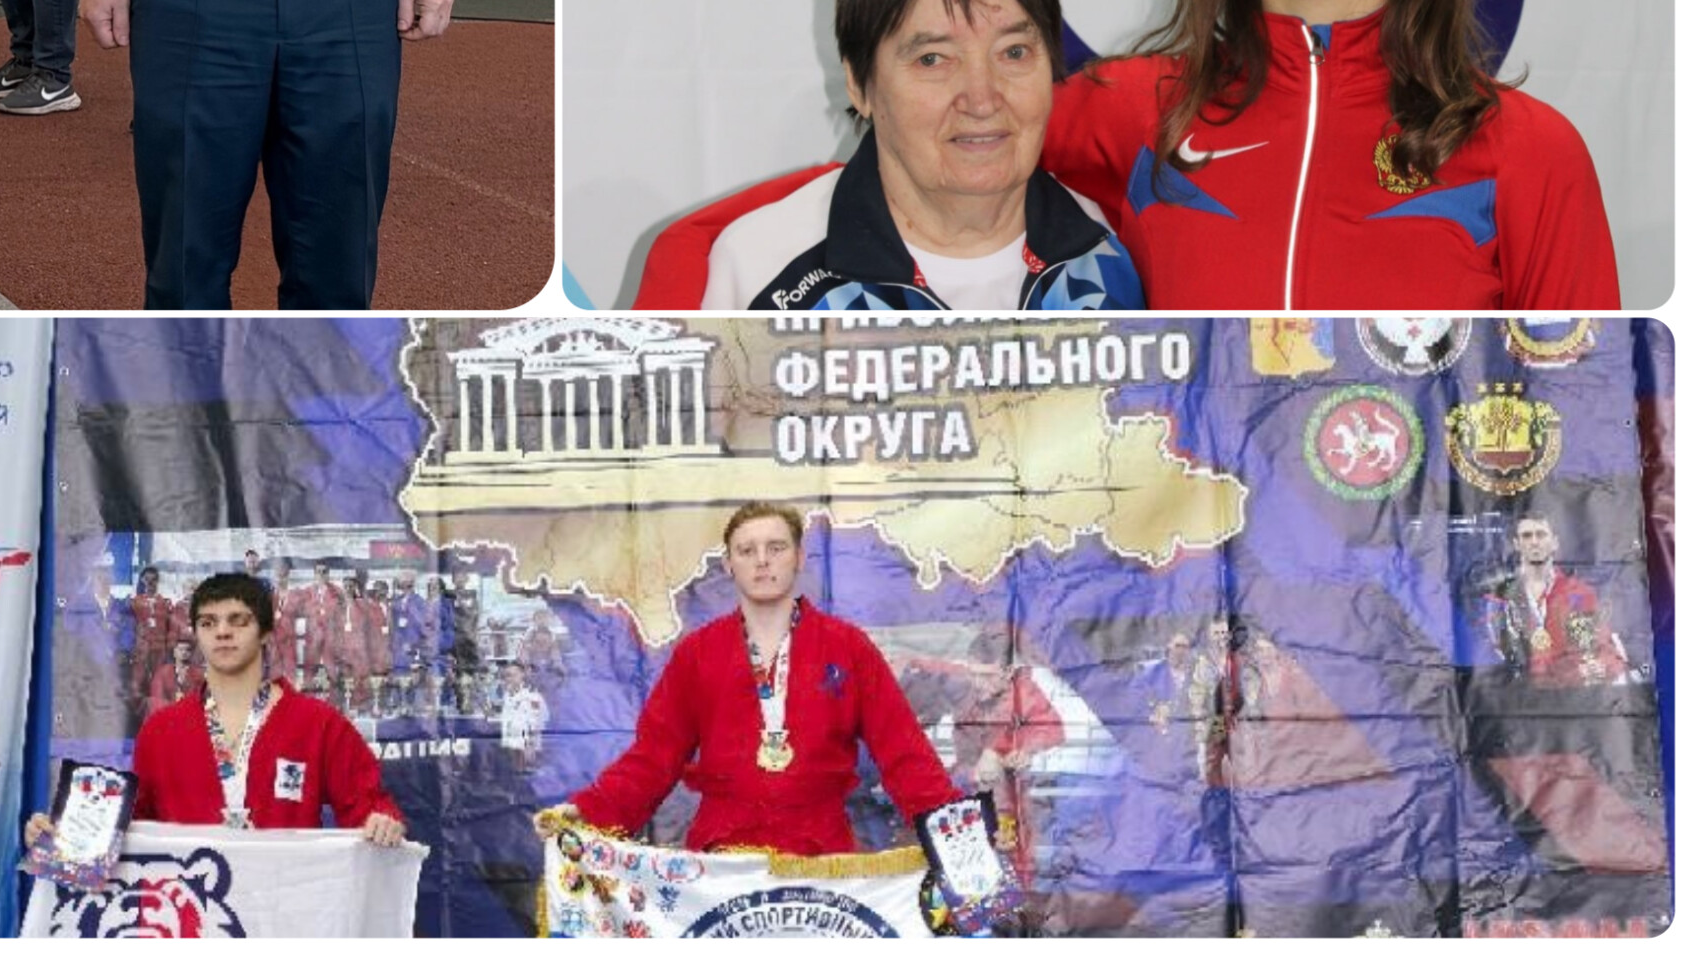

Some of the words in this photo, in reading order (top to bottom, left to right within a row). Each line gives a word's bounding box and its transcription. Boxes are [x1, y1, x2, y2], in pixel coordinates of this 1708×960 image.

[772, 268, 841, 310] FORWA
[774, 332, 1191, 401] ФЕДЕРАЛЬНОГО
[776, 410, 972, 461] ОКРУГА
